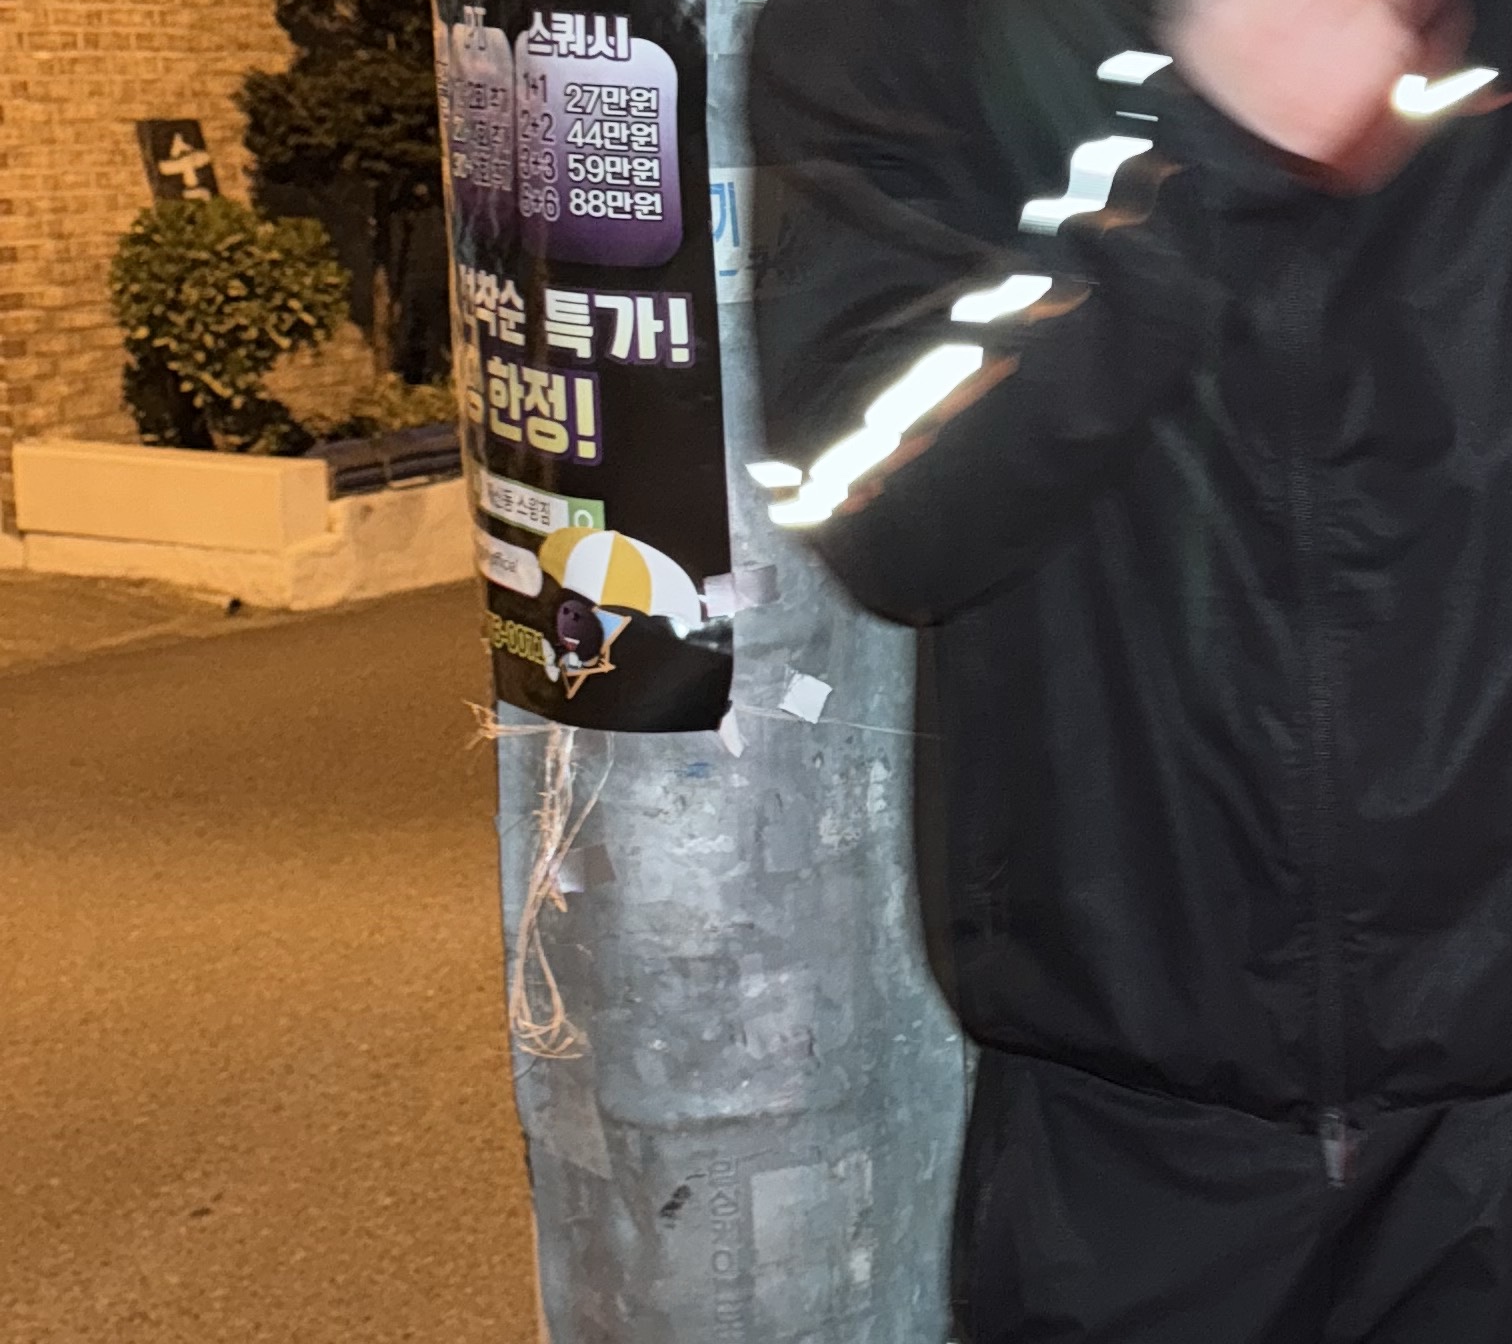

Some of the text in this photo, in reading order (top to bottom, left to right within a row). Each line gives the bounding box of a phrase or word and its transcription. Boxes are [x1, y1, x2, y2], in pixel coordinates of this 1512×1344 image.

[527, 11, 629, 59] 스쿼시
[565, 83, 660, 117] 27만원
[567, 119, 660, 152] 44만원
[568, 155, 661, 188] 59만원
[569, 187, 664, 221] 88만원
[544, 288, 691, 363] 특가!
[487, 356, 597, 459] 한정!
